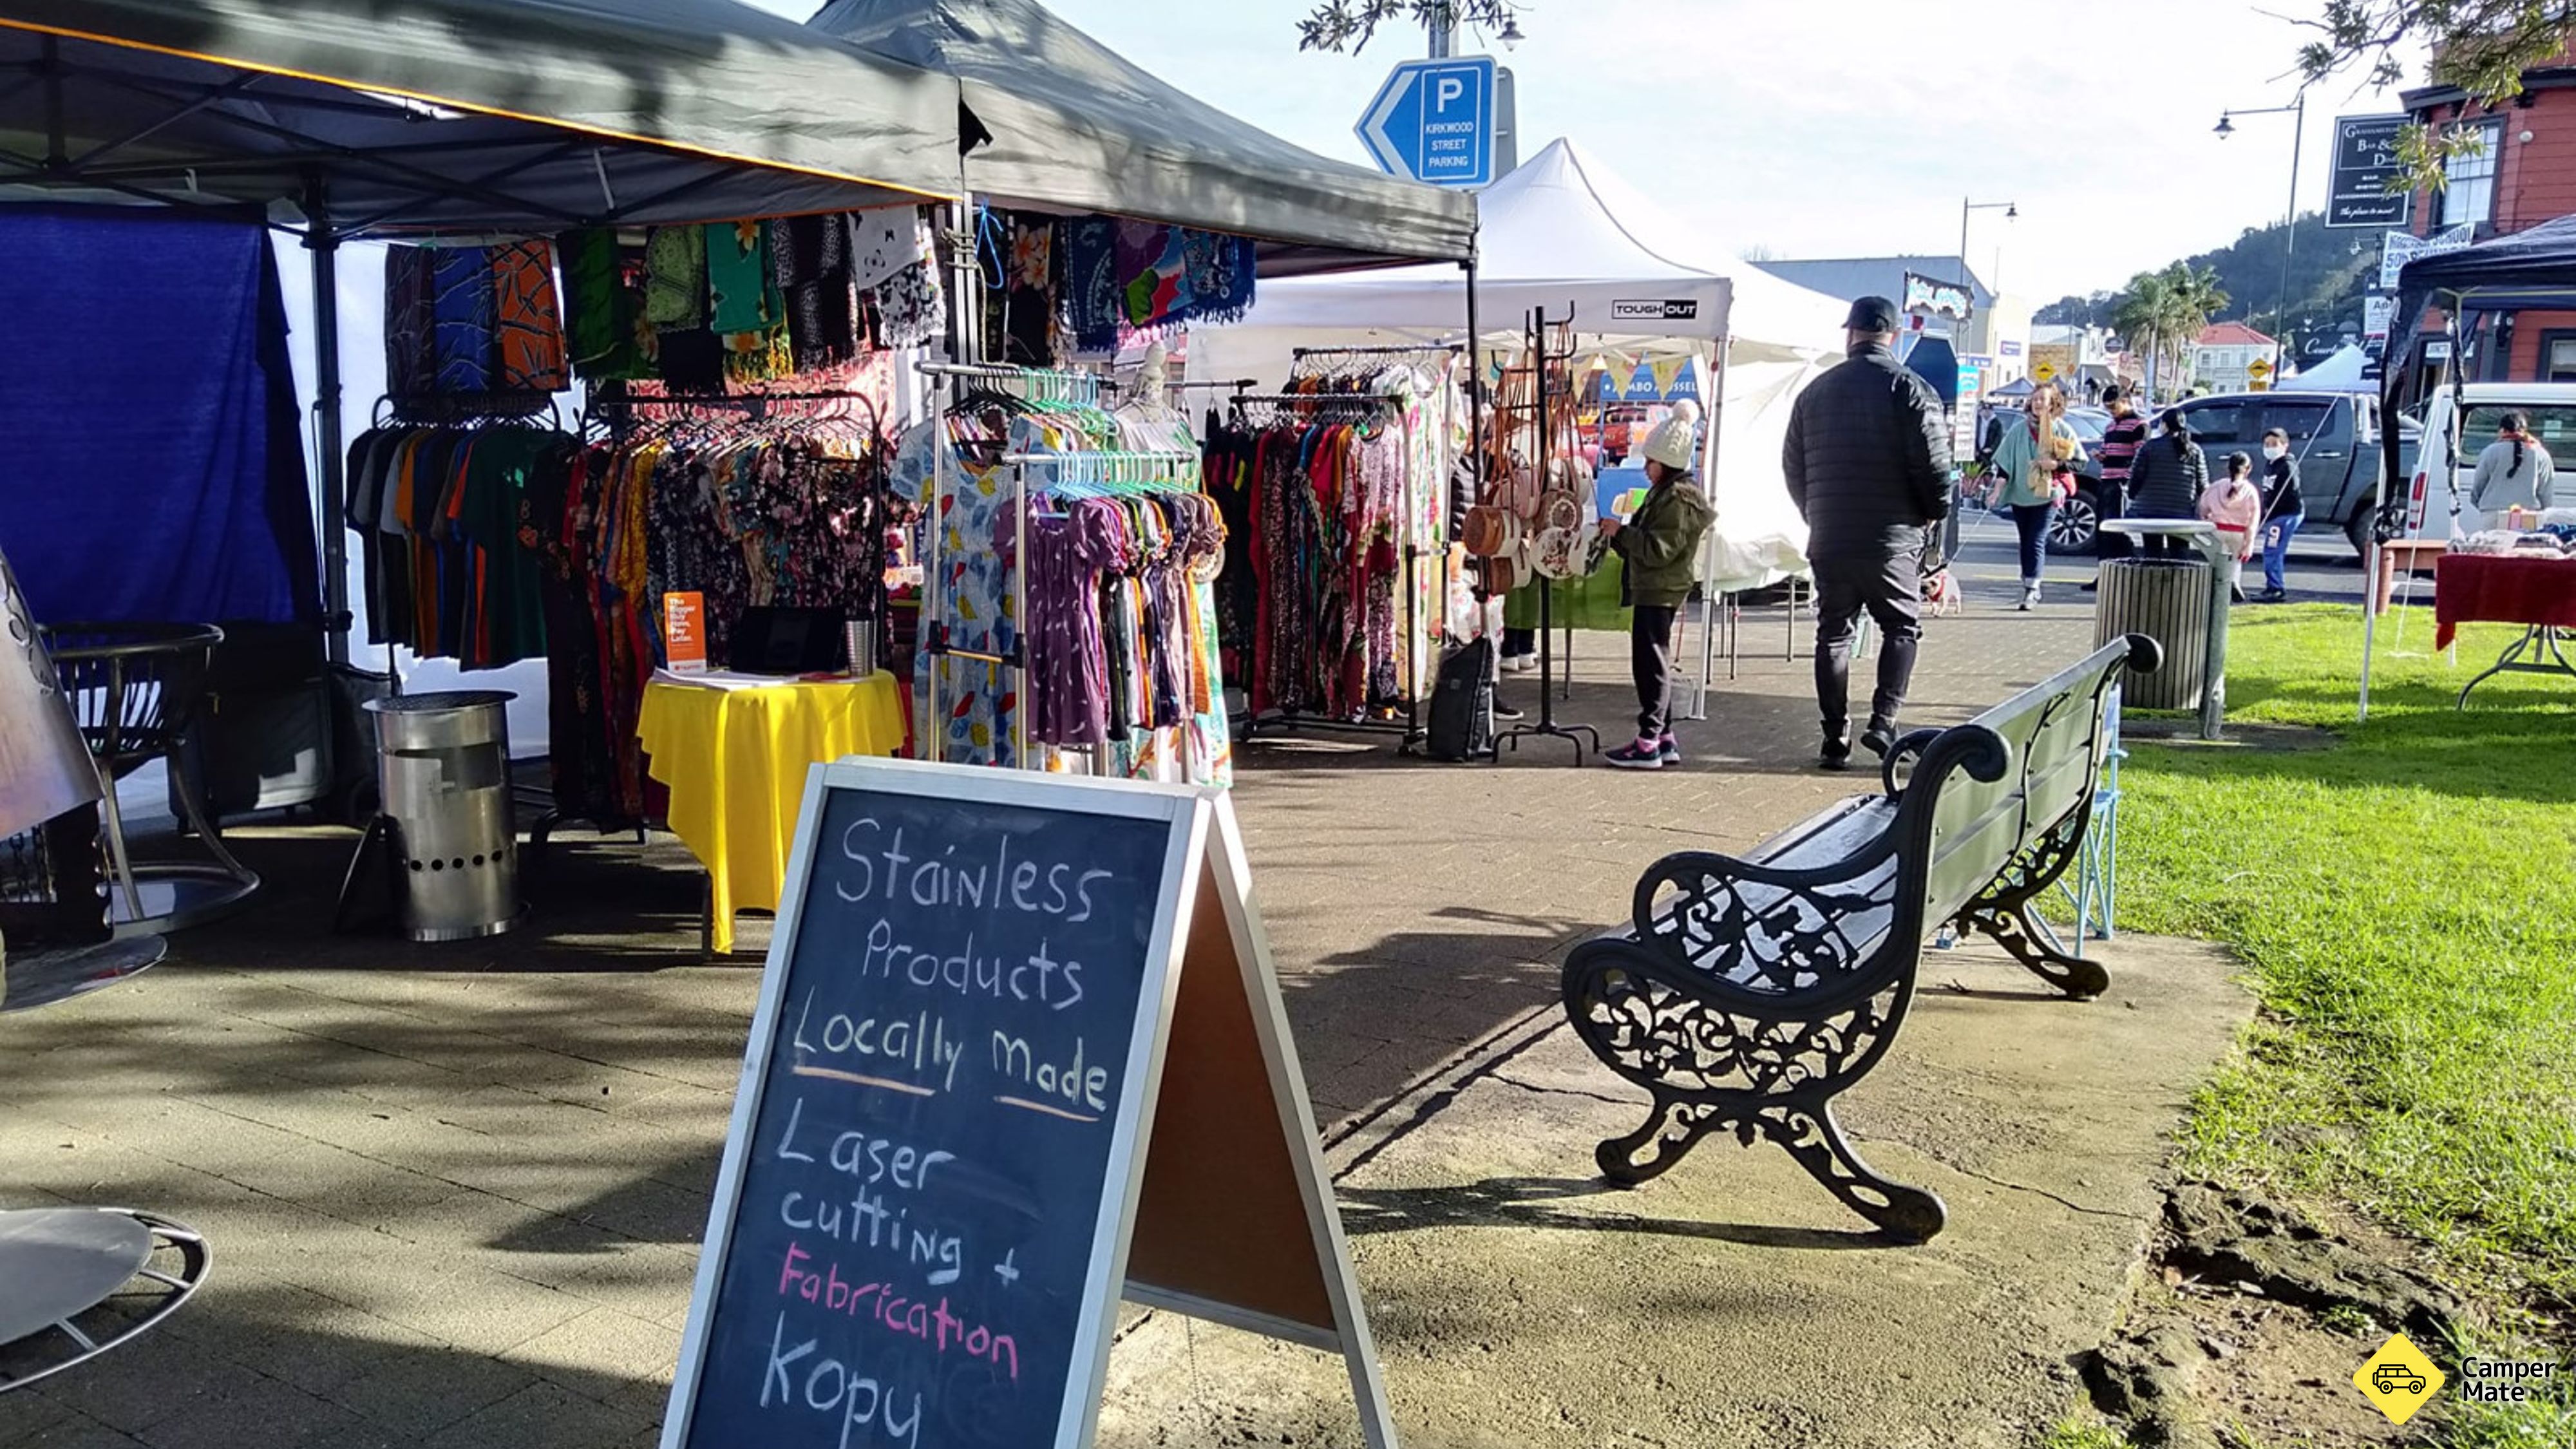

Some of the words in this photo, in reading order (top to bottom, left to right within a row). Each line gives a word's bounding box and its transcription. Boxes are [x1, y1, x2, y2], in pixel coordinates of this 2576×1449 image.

[1437, 78, 1463, 113] P
[1425, 121, 1474, 134] KIRKWOOD
[1431, 138, 1467, 151] STREET
[1428, 156, 1469, 168] PARKING
[1616, 305, 1663, 314] TOUGH
[1665, 305, 1696, 314] OUT
[836, 818, 1113, 923] Stainless
[862, 918, 1083, 1011] Products
[793, 985, 963, 1092] Locally
[777, 1097, 956, 1189] Laser
[994, 1247, 1020, 1288] +
[779, 1241, 1018, 1381] Fabrication
